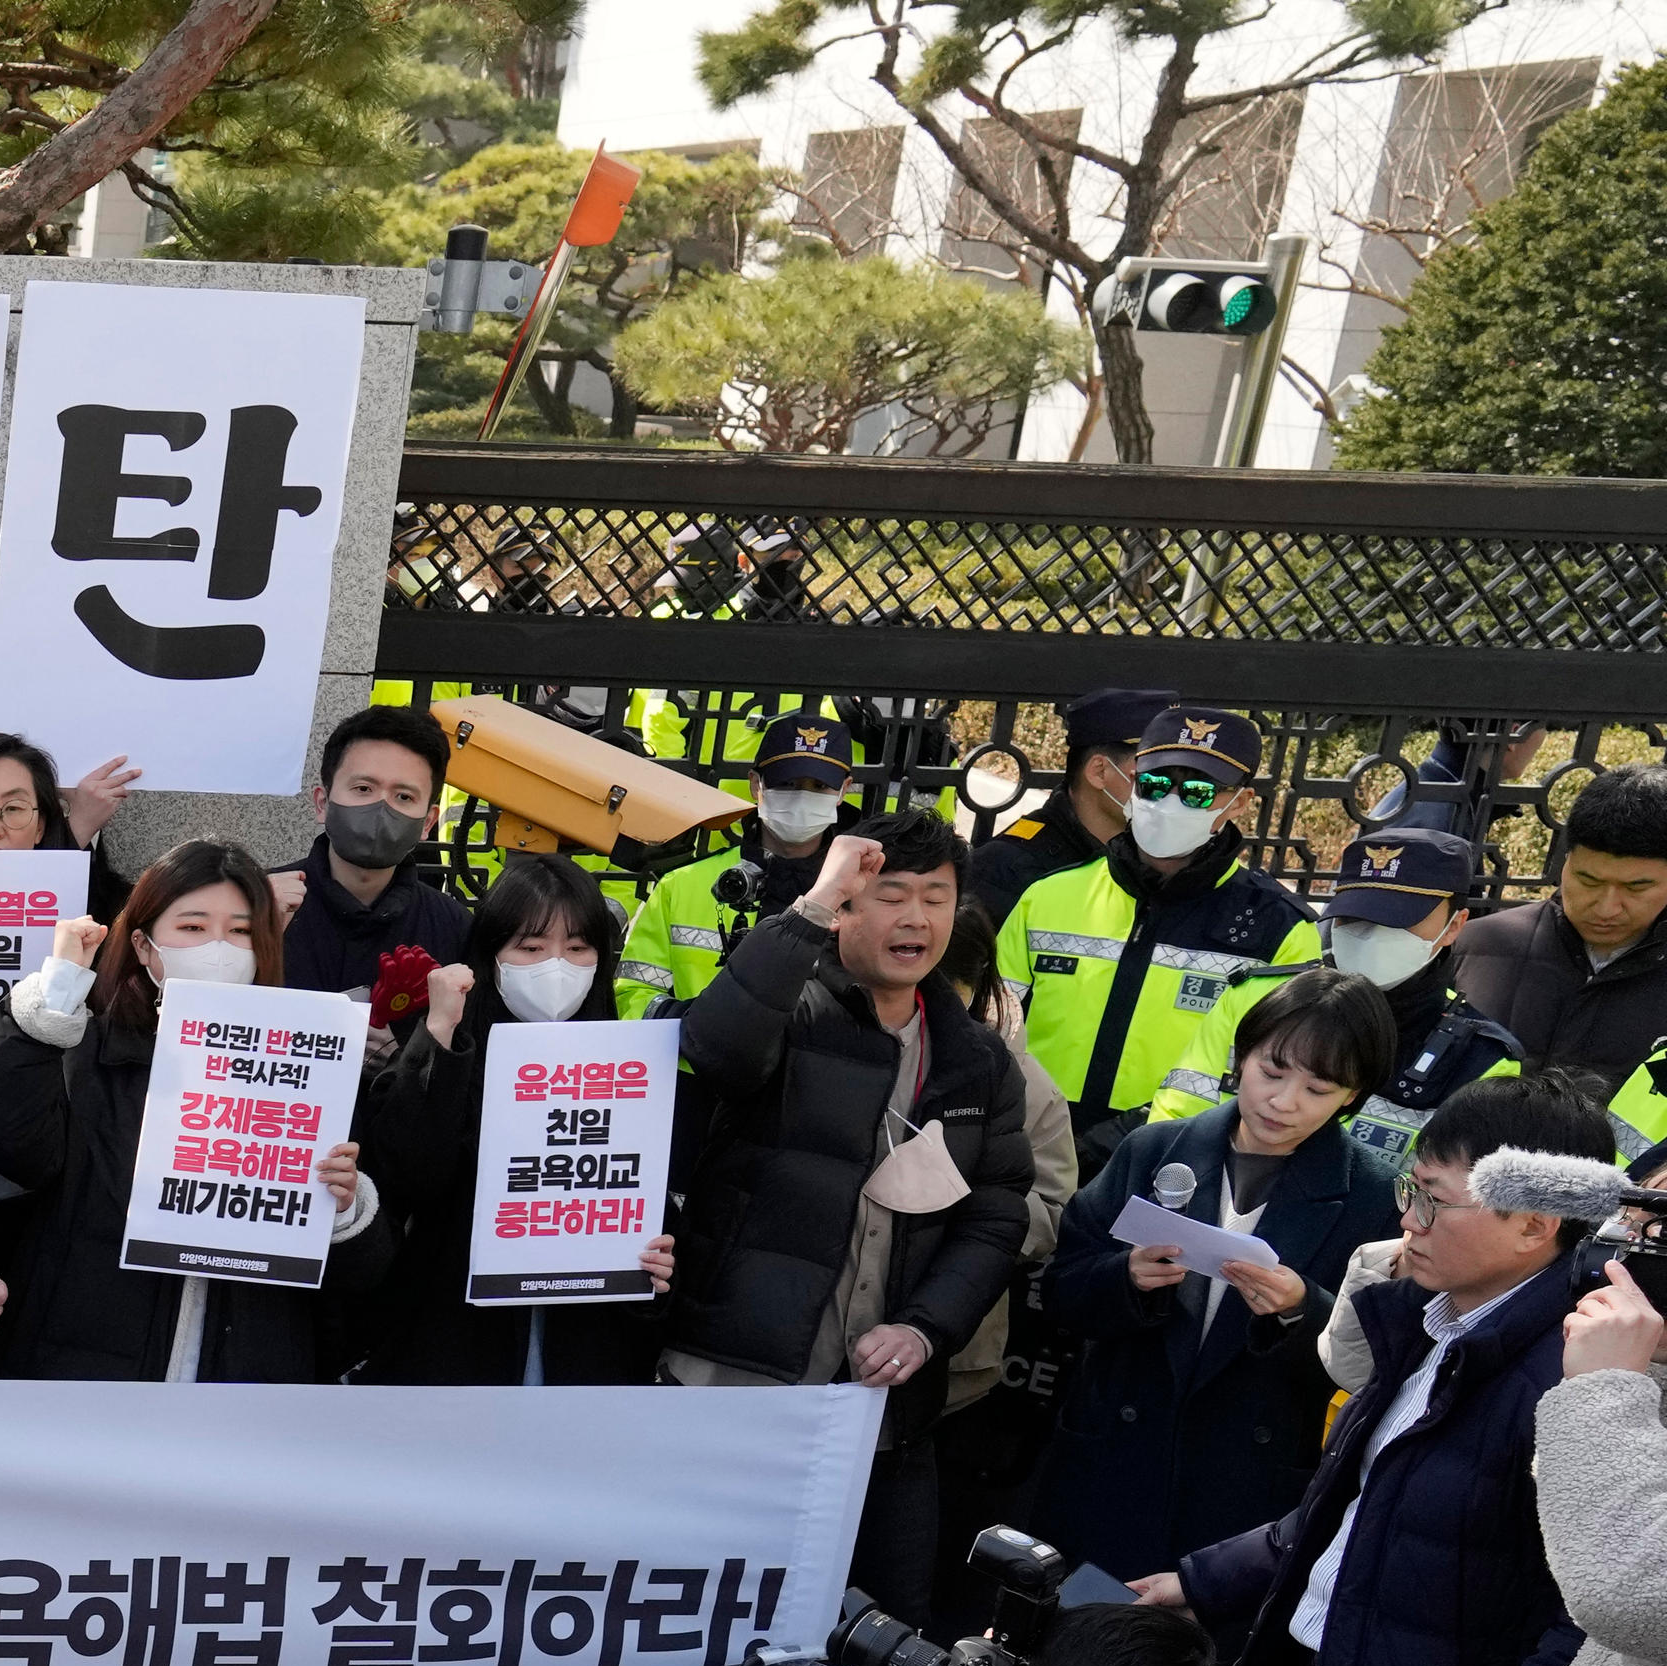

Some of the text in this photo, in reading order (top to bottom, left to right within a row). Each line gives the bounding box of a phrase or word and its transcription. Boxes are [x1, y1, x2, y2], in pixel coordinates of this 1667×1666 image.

[51, 404, 322, 680] 탄
[1181, 997, 1216, 1009] POLI
[181, 1020, 345, 1061] 반인권! 반헌법!
[206, 1055, 310, 1089] 반역사적!
[515, 1061, 648, 1101] 윤석열은
[181, 1092, 322, 1141] 강제동원
[546, 1109, 611, 1146] 친일
[944, 1107, 986, 1118] MERRELL
[1356, 1122, 1405, 1152] 경찰
[171, 1136, 313, 1184] 굴욕해법
[508, 1154, 640, 1192] 굴욕외교
[158, 1177, 311, 1226] 폐기하라!
[495, 1198, 644, 1238] 중단하라!
[180, 1253, 269, 1272] 한일역사정의평화행동
[521, 1279, 605, 1290] 한일역사정의평화행동
